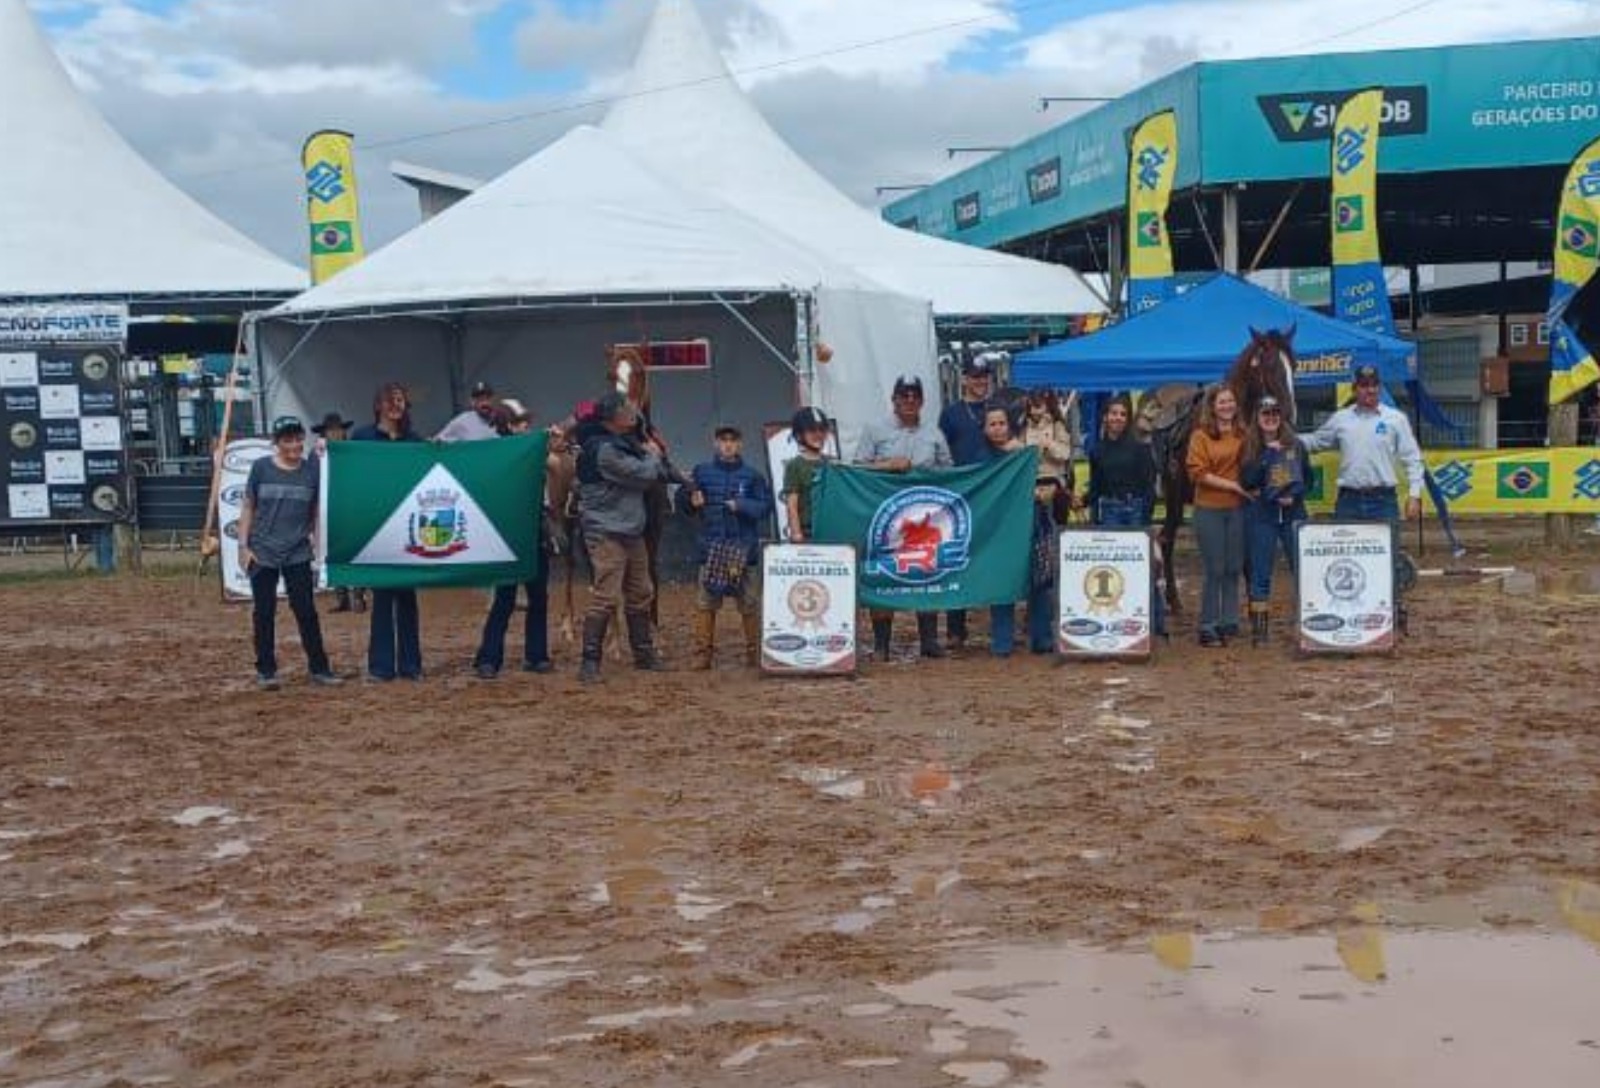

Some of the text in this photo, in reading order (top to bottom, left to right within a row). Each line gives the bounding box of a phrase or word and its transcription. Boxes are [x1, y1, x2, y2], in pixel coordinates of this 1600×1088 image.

[1504, 82, 1593, 100] PARCEIRO
[1313, 100, 1411, 127] SIOB
[1472, 103, 1597, 127] GERAÇÕES DO
